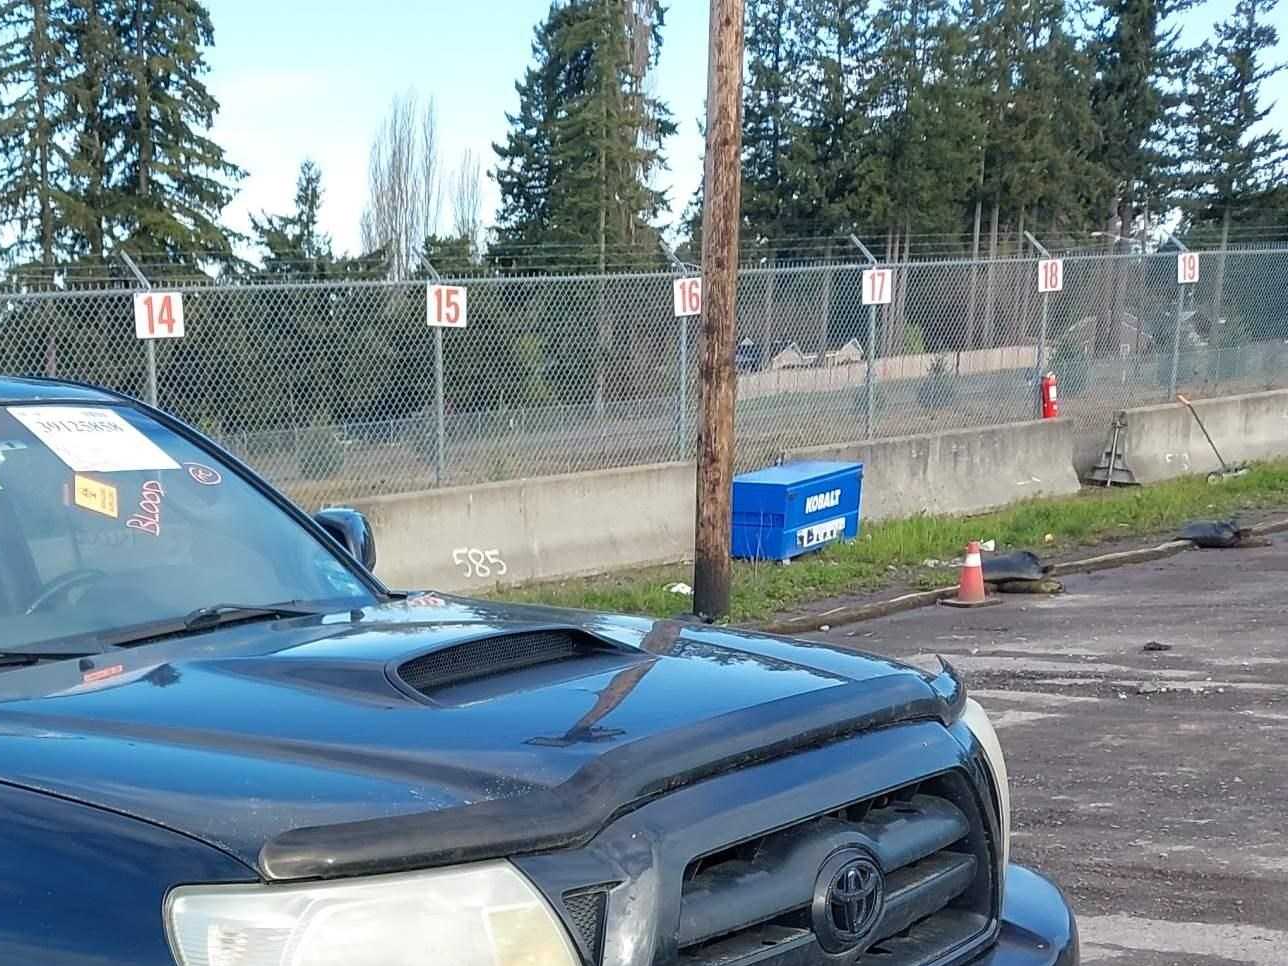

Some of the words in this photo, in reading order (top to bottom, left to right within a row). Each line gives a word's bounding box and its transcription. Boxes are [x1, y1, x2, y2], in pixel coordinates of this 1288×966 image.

[1043, 261, 1058, 289] 18
[1182, 255, 1196, 280] 19
[679, 279, 700, 313] 16
[869, 271, 885, 301] 17
[143, 295, 176, 335] 14
[434, 288, 460, 323] 15
[805, 488, 842, 514] KOBALT
[453, 547, 507, 578] 585
